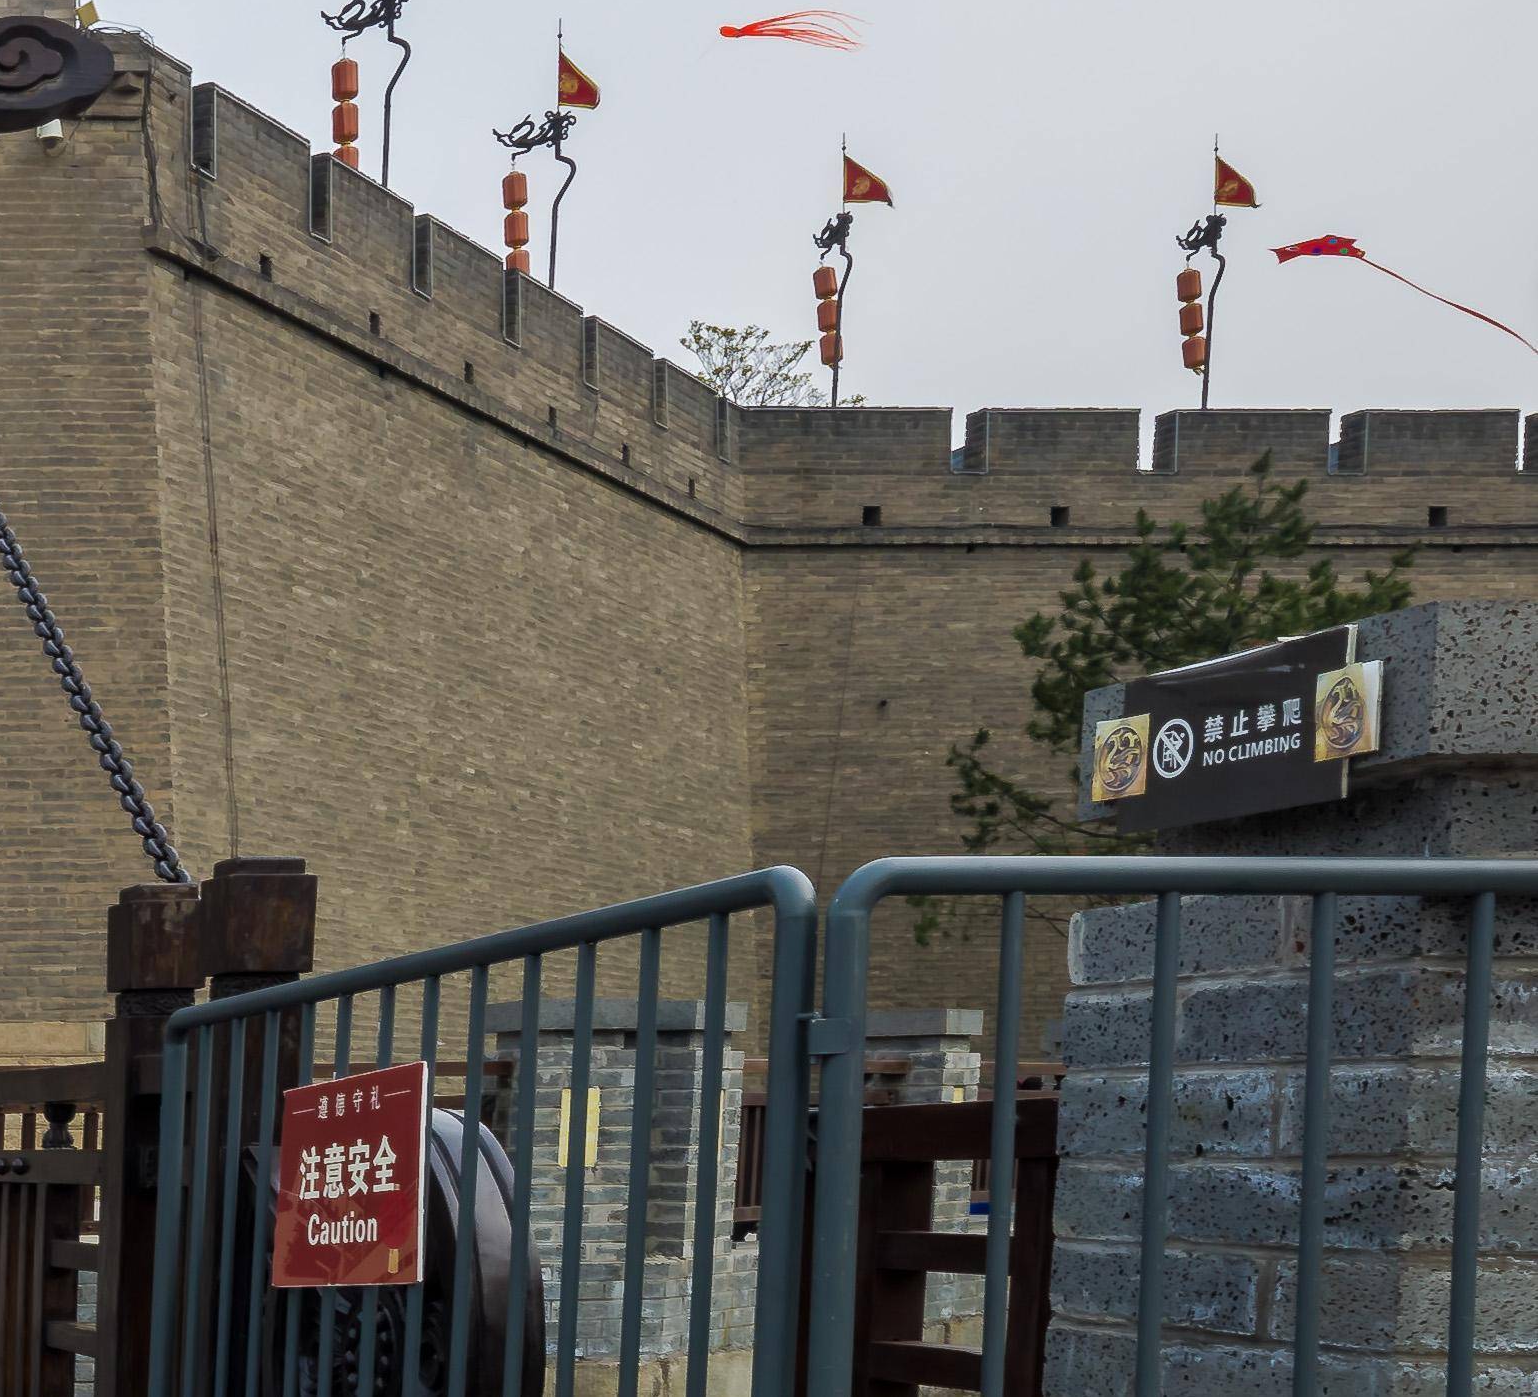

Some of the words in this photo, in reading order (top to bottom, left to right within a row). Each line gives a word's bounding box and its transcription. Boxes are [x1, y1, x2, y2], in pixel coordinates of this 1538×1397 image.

[1204, 698, 1302, 743] 禁止攀爬
[1203, 748, 1225, 767] NO
[1228, 732, 1301, 762] CLIMBING
[299, 1134, 396, 1200] 注意安全
[307, 1210, 378, 1246] Caution
